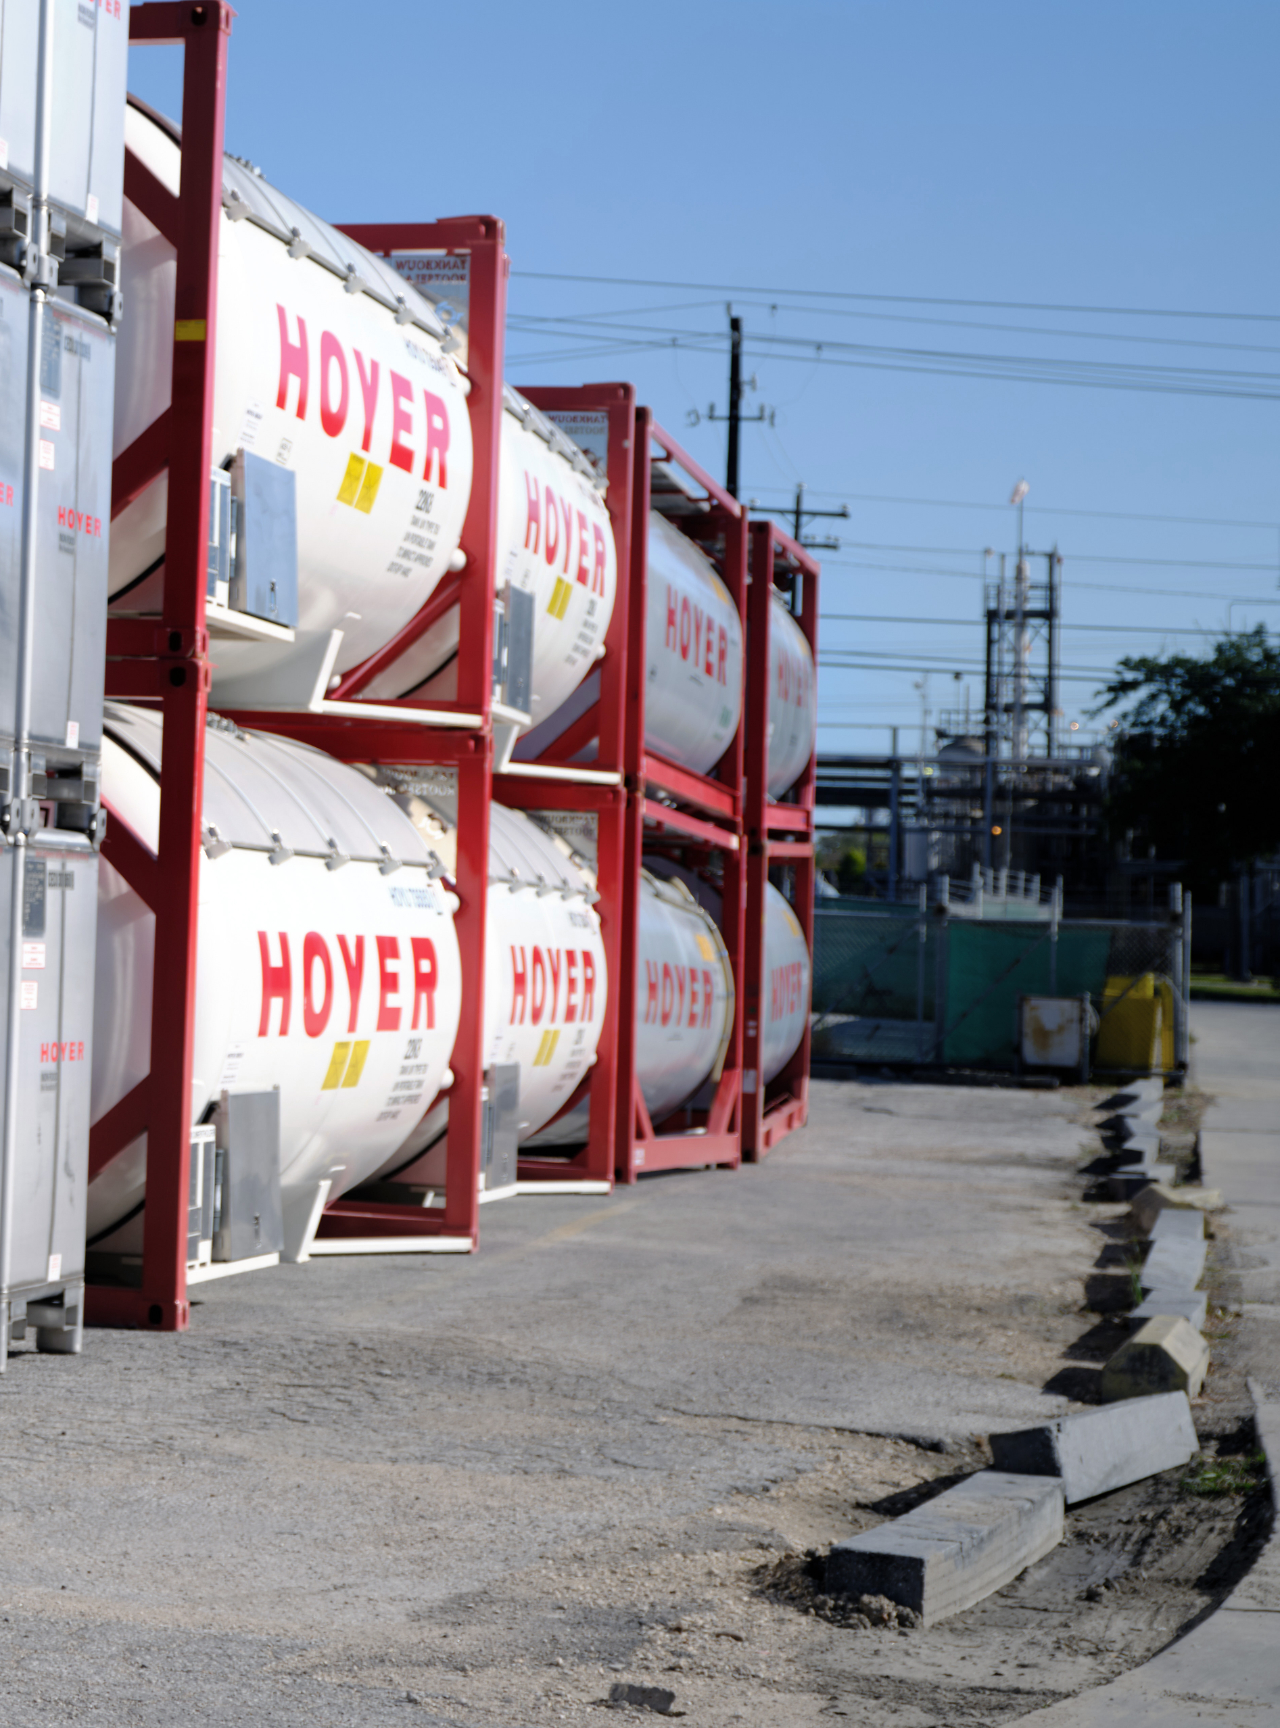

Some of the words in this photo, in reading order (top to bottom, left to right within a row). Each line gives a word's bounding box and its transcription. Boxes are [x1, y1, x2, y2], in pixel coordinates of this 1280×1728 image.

[275, 302, 452, 490] HOYER
[57, 505, 102, 537] HOYER
[524, 468, 607, 598] HOYER
[665, 583, 729, 687] HOYER
[257, 930, 439, 1038] HOYER
[509, 944, 597, 1027] HOYER
[644, 958, 713, 1030] HOYER
[771, 961, 802, 1023] HOYER
[40, 1041, 85, 1063] HOYER
